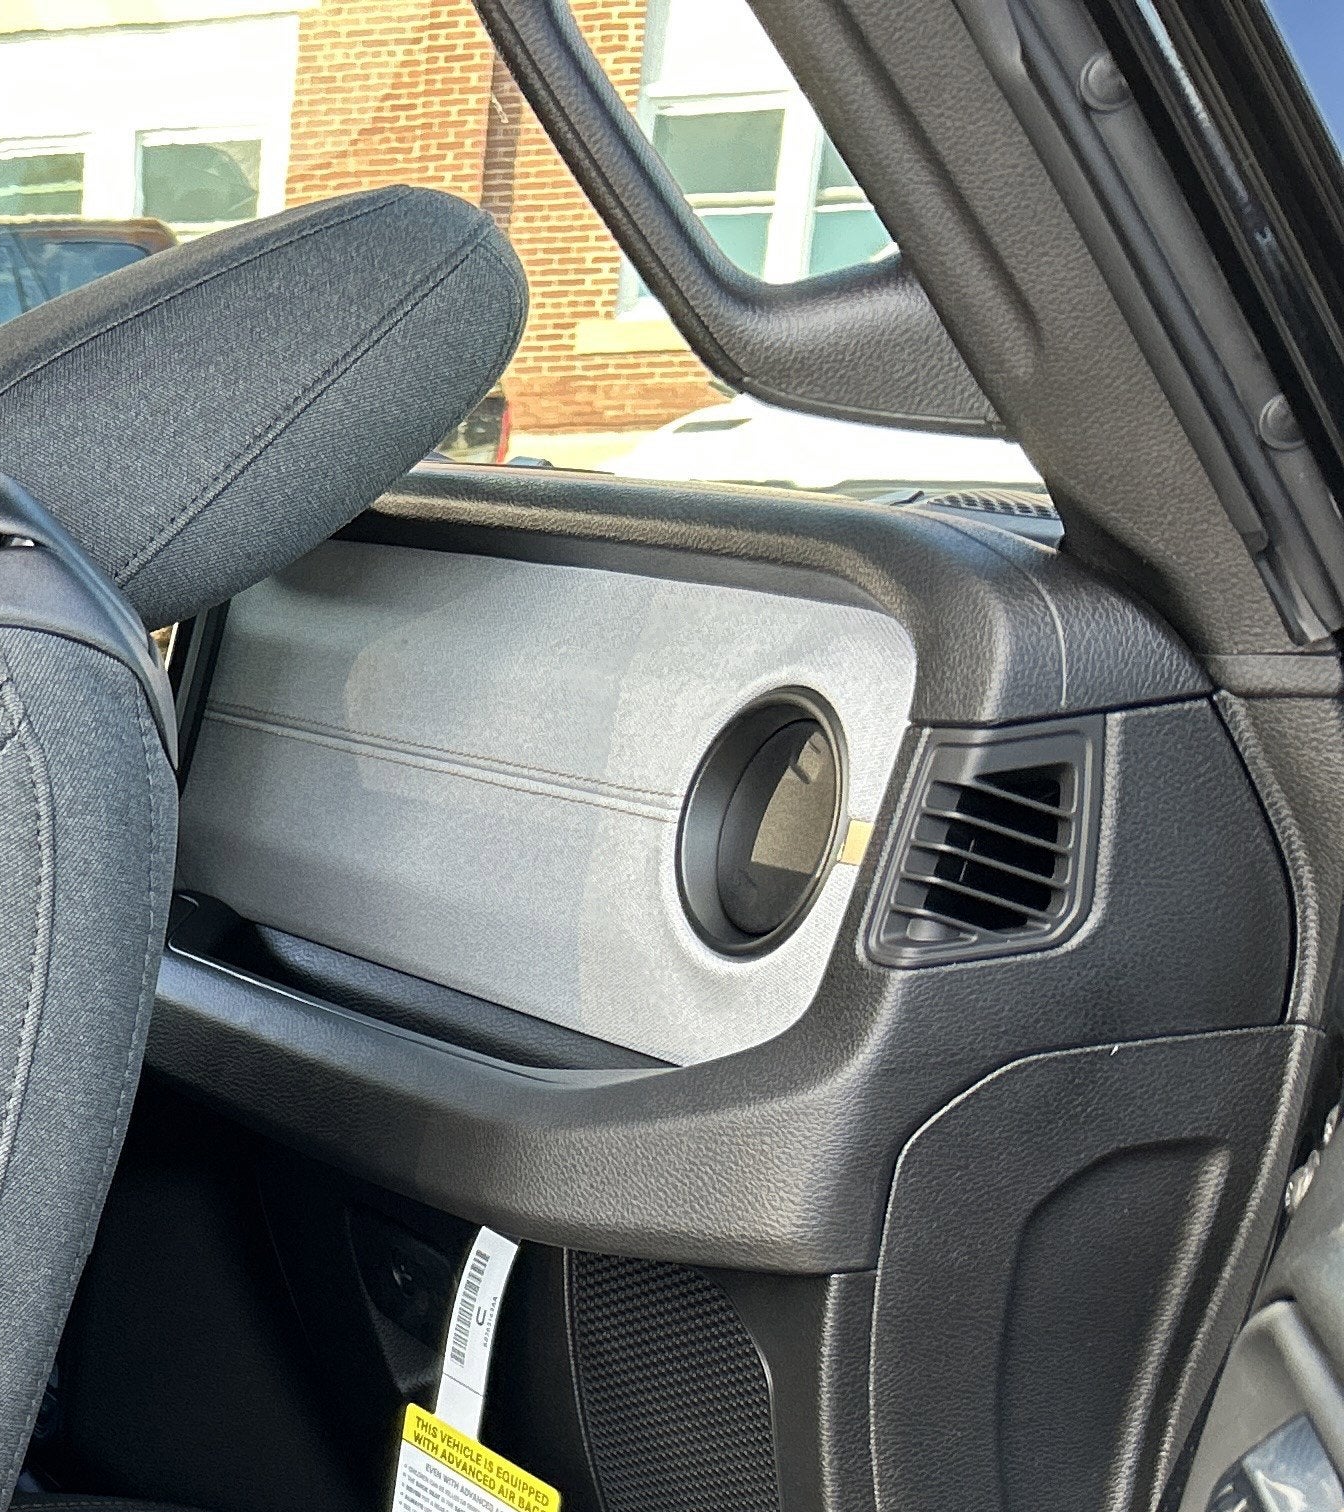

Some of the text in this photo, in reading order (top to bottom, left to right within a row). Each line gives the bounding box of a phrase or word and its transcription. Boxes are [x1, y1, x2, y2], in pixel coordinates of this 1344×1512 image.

[414, 1429, 439, 1456] WITH
[440, 1449, 496, 1490] ADVANCED
[498, 1484, 516, 1504] AIR
[416, 1415, 438, 1438] THIS
[440, 1430, 483, 1466] VEHICLE
[484, 1458, 494, 1473] IS
[496, 1466, 550, 1507] EQUIPPED
